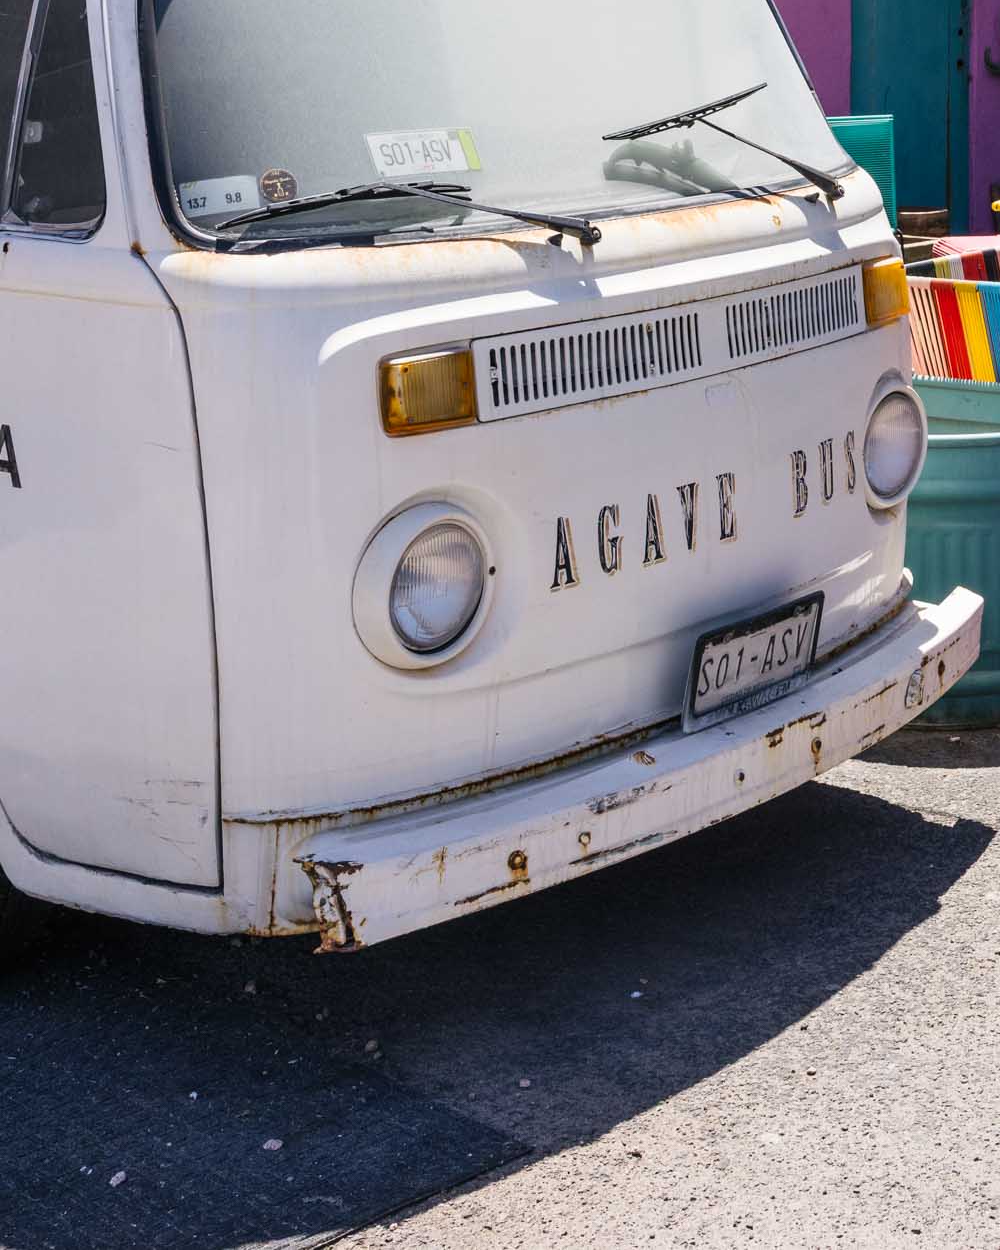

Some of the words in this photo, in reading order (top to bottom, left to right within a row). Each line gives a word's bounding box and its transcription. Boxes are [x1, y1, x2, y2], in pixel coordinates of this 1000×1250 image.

[186, 196, 208, 210] 13.7
[225, 191, 242, 204] 9.8
[550, 471, 738, 592] AGAVE
[790, 429, 857, 518] BUS
